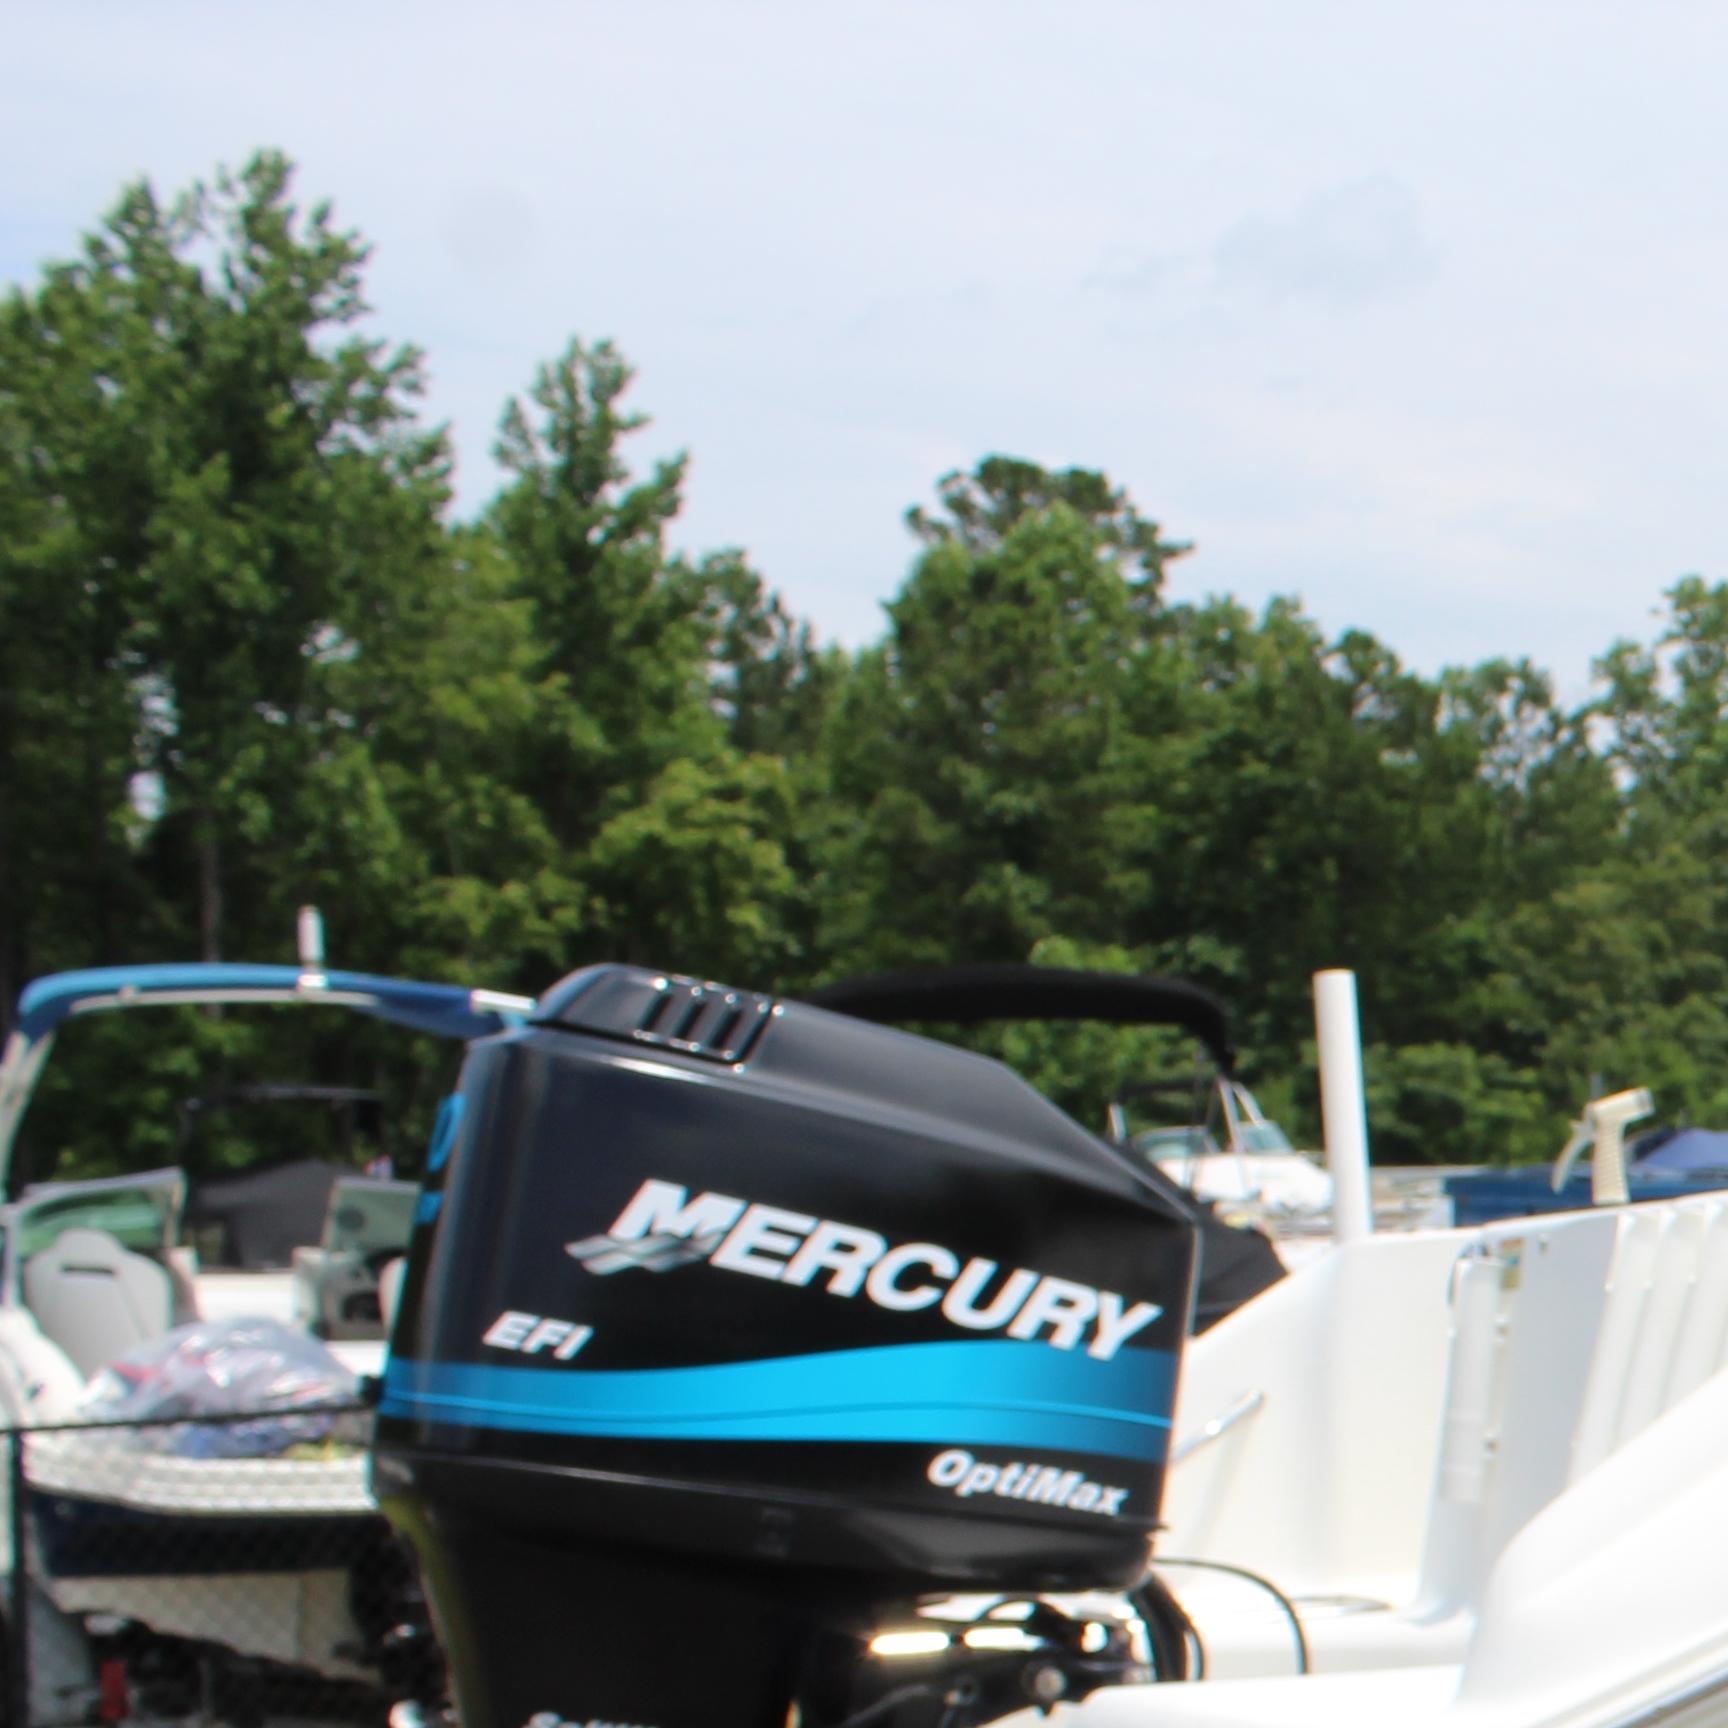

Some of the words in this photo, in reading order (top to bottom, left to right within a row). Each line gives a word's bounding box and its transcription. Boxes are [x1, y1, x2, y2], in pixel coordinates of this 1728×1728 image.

[603, 1179, 1163, 1361] MERCURY
[481, 1310, 595, 1361] EFI
[926, 1449, 1130, 1516] OptiMax
